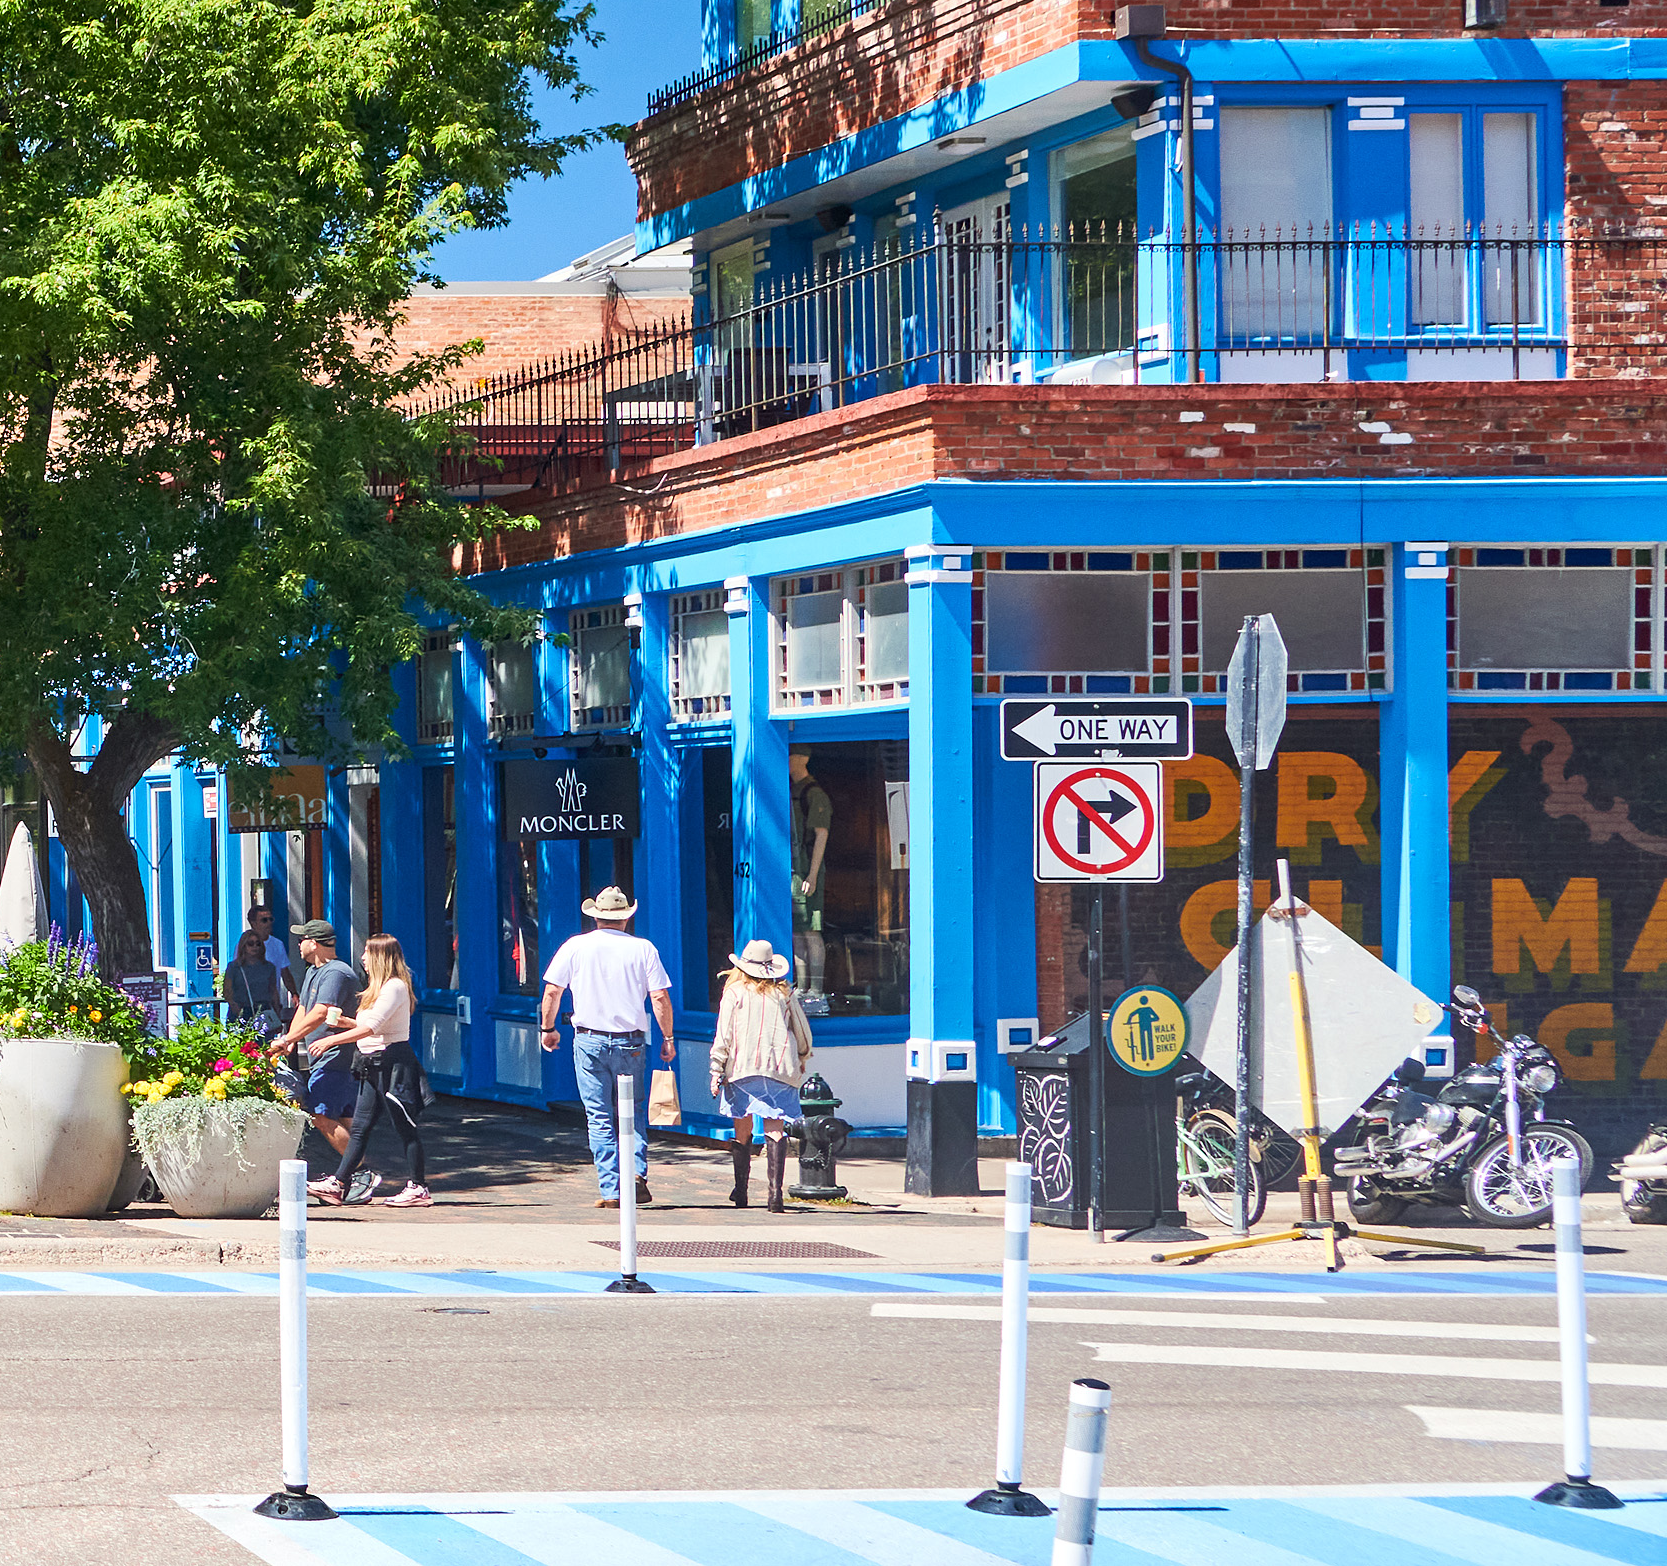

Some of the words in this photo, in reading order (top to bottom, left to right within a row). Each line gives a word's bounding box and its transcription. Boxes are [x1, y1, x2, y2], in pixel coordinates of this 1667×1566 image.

[1059, 719, 1109, 740] ONE
[1118, 719, 1169, 740] WAY
[519, 814, 626, 833] MONCLER
[734, 861, 750, 879] 432
[1154, 1024, 1175, 1033] WALK
[1155, 1034, 1176, 1044] YOUR
[1156, 1043, 1177, 1053] BIKE!
